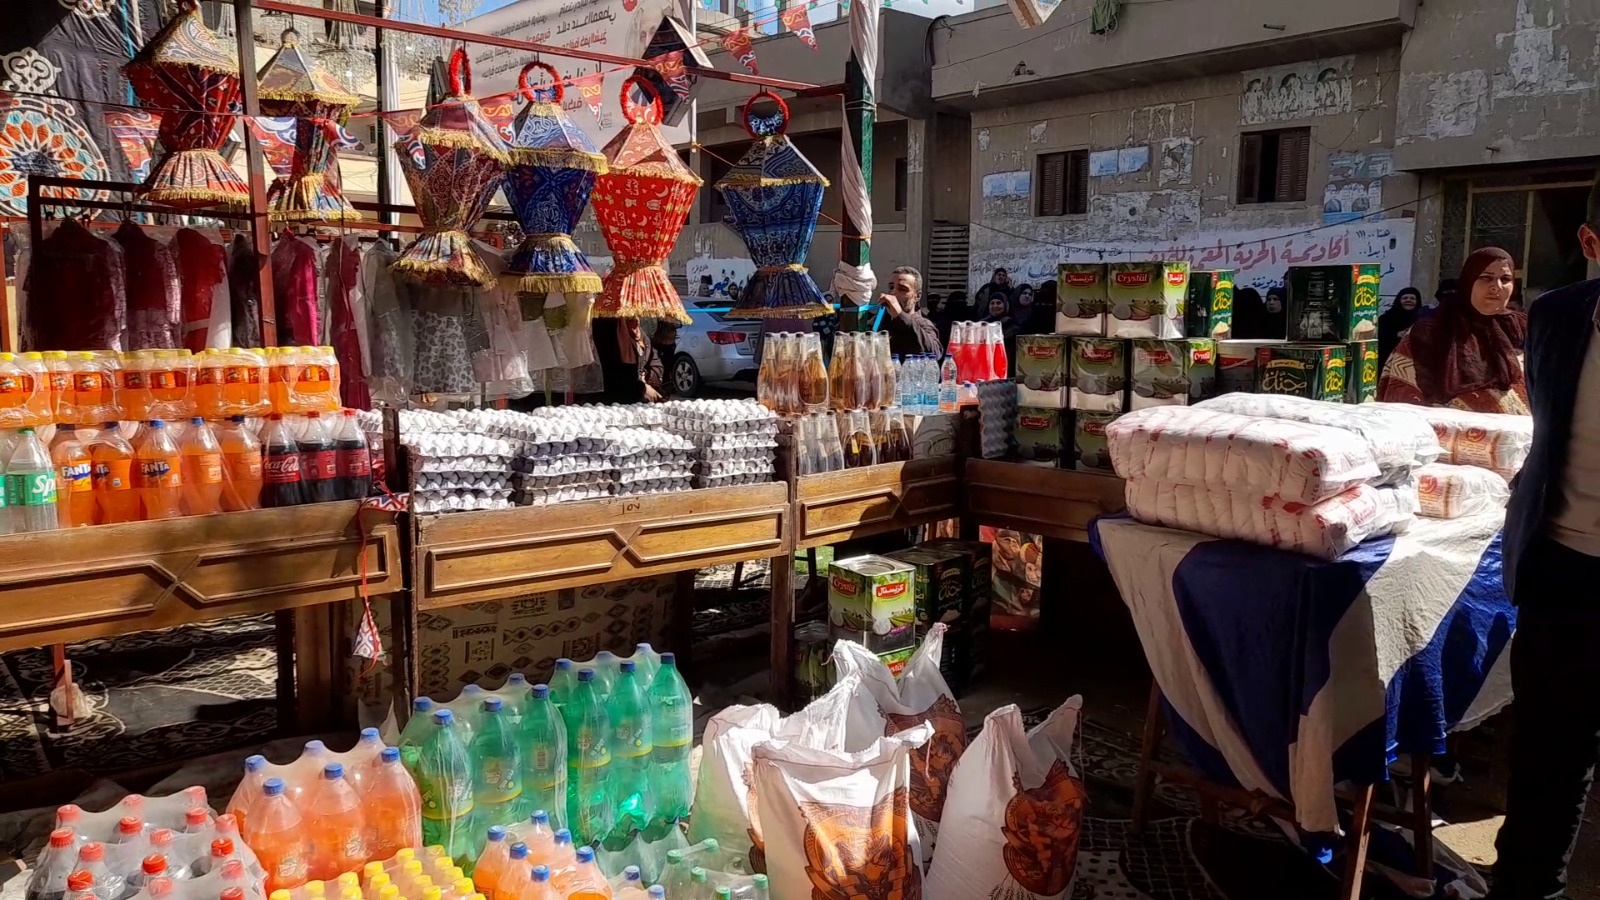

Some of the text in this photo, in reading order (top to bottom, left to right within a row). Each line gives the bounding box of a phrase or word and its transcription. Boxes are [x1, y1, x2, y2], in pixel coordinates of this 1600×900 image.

[1067, 274, 1094, 284] كريستال
[1030, 346, 1057, 356] كريستال
[140, 462, 170, 474] FANTA
[878, 584, 905, 596] كريستال
